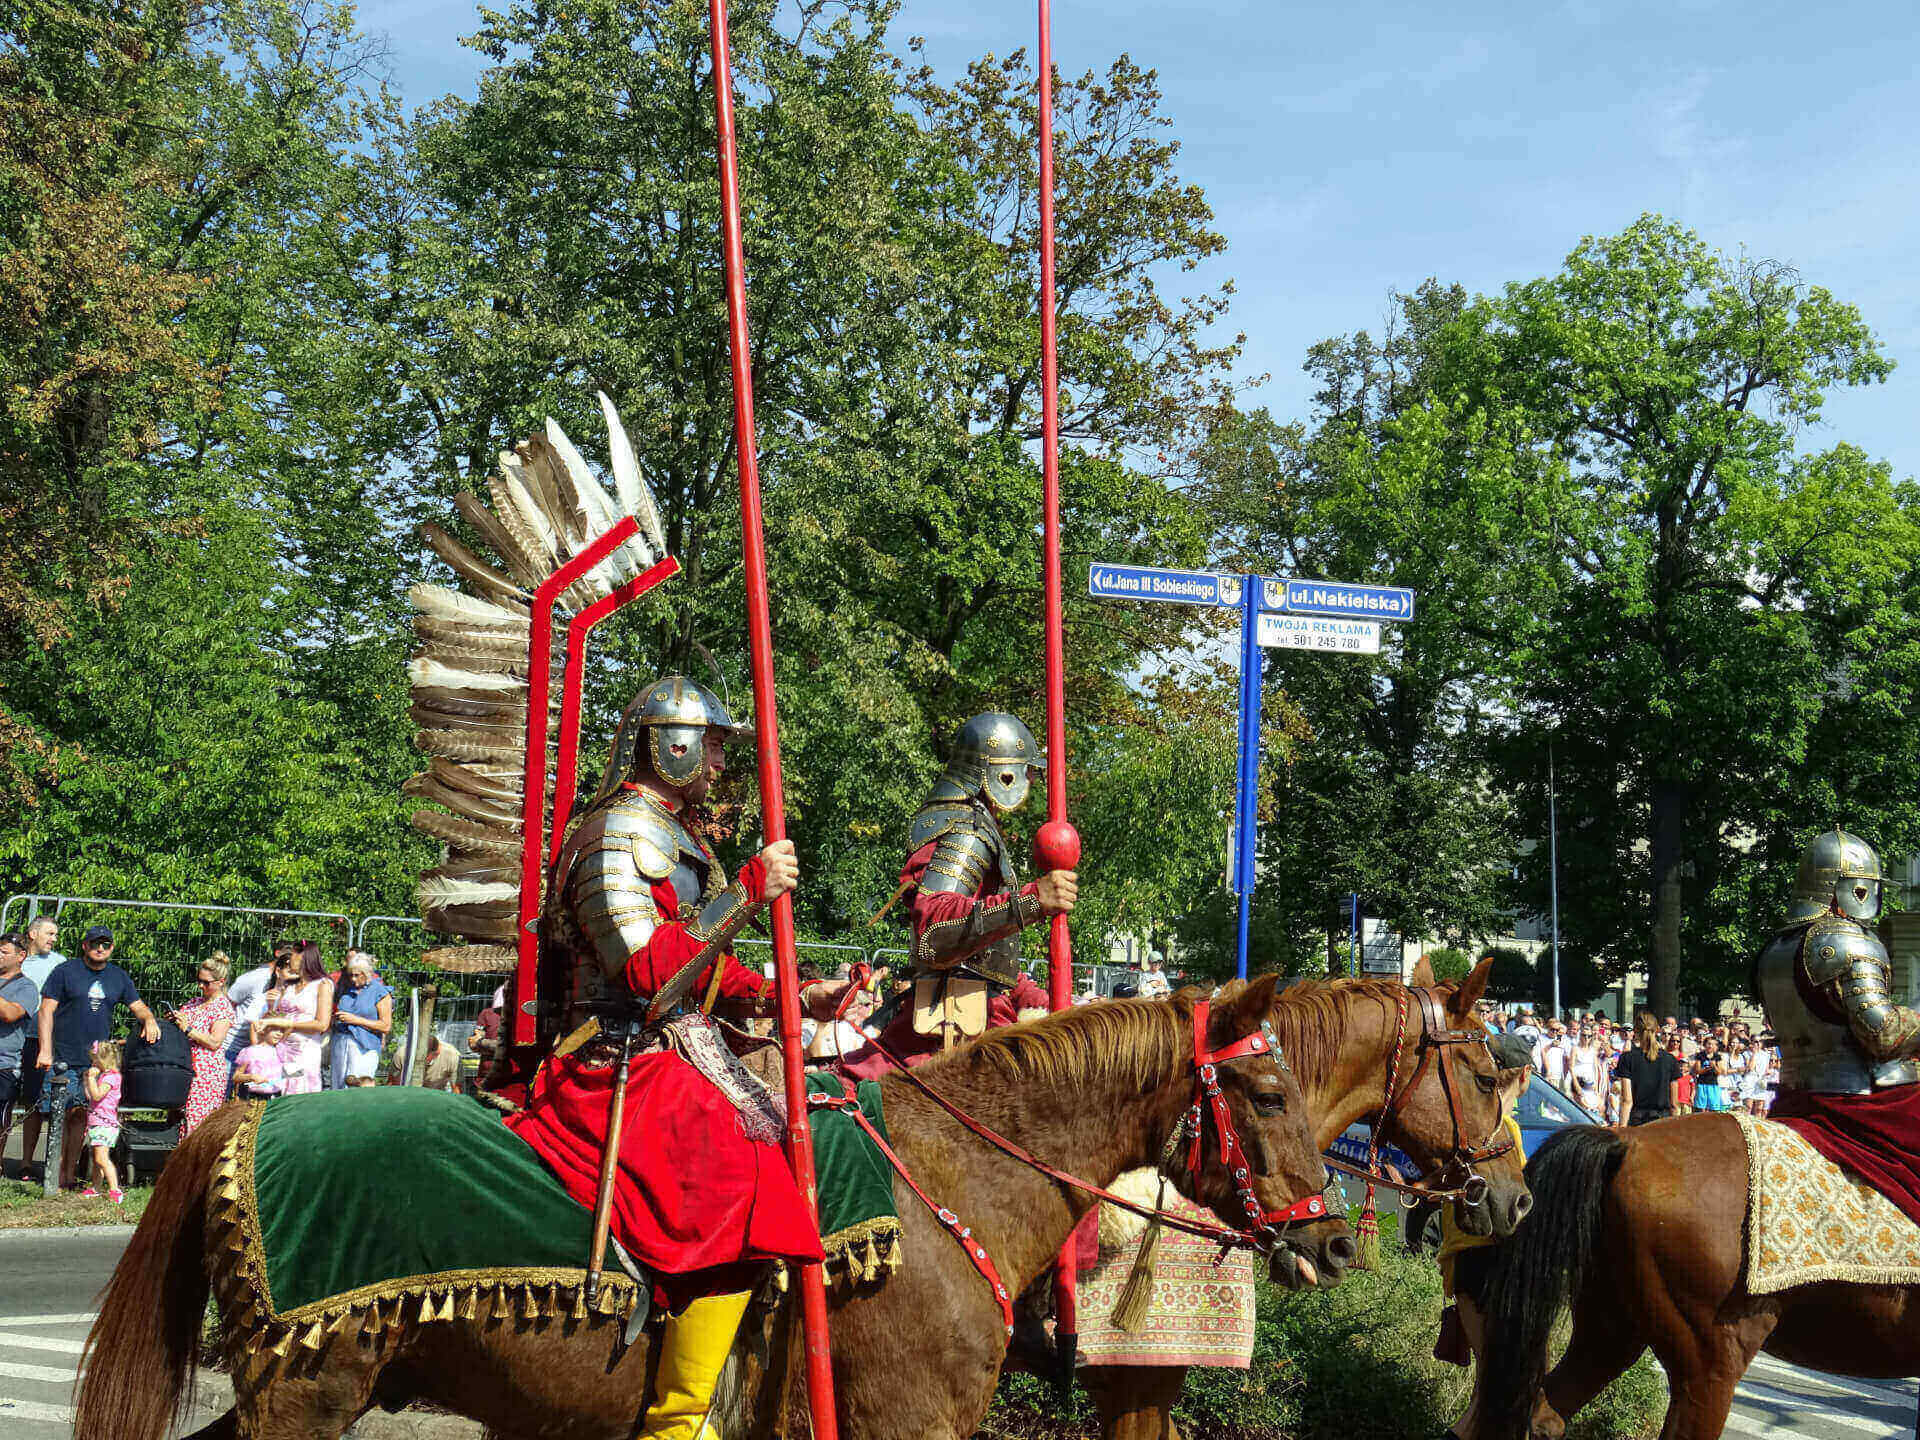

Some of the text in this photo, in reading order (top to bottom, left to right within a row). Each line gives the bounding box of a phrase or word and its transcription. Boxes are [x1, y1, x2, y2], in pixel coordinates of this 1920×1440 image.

[1141, 576, 1151, 591] III
[1153, 577, 1215, 600] Sobieskiego
[1265, 618, 1372, 636] TWOJA REKLAMA
[1318, 636, 1336, 648] 245
